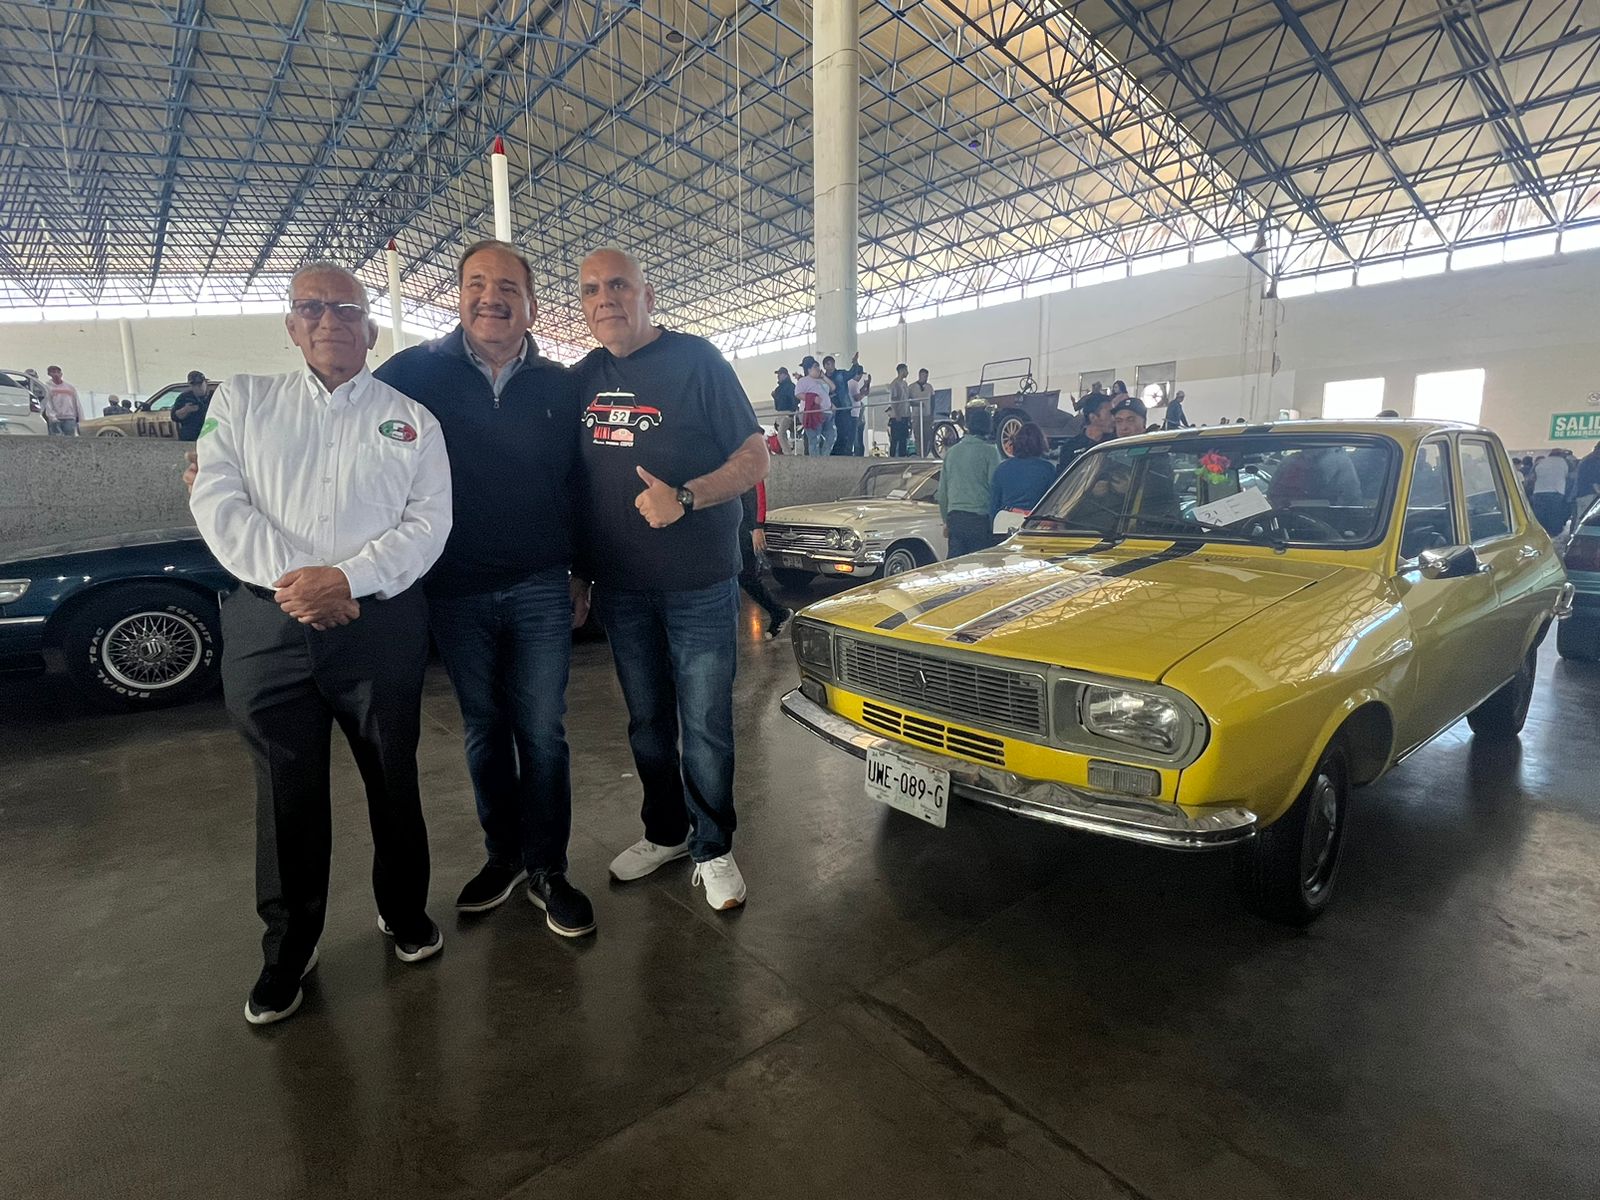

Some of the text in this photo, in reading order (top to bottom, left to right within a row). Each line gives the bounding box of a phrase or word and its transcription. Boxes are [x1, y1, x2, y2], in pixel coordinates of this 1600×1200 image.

[611, 411, 627, 422] 52
[593, 426, 610, 439] MINI
[89, 627, 151, 698] RADIAL TRAC
[868, 759, 944, 808] UWE-089-G
